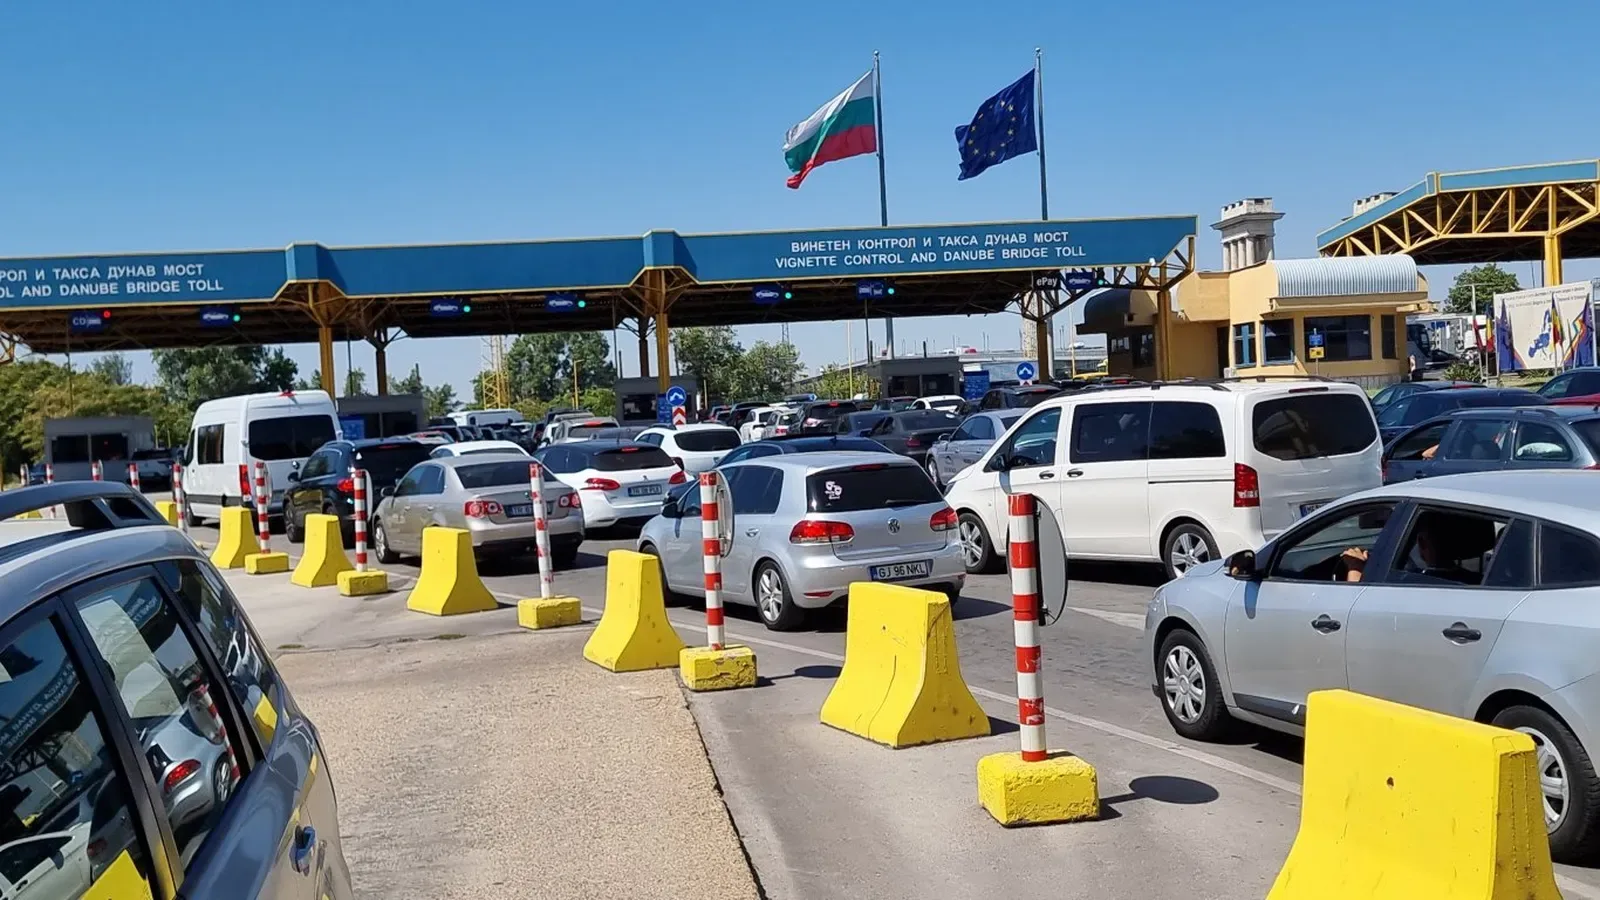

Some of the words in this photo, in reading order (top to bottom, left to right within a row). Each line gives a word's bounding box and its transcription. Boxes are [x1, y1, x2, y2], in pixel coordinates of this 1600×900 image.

[791, 240, 851, 253] ВИНЕТЕН
[857, 238, 916, 250] КОНТРОЛ
[923, 237, 932, 247] И
[938, 235, 978, 247] ТАКСА
[984, 233, 1027, 247] ДУНАВ
[1033, 231, 1069, 243] МОСТ
[775, 255, 838, 269] VIGNETTE
[843, 253, 904, 266] CONTROL
[910, 252, 937, 264] AND
[943, 249, 995, 262] DANUBE
[1002, 247, 1049, 259] BRIDGE
[1055, 246, 1087, 258] TOLL
[35, 268, 45, 281] И
[52, 266, 100, 280] ТАКСА
[107, 264, 157, 280] ДУНАВ
[164, 263, 204, 276] МОСТ
[21, 284, 52, 298] AND
[59, 282, 119, 297] DANUBE
[126, 280, 181, 294] BRIDGE
[187, 278, 224, 292] TOLL
[1036, 276, 1058, 288] ePay
[878, 566, 892, 578] GJ
[893, 565, 906, 577] 96
[906, 563, 926, 575] NKL
